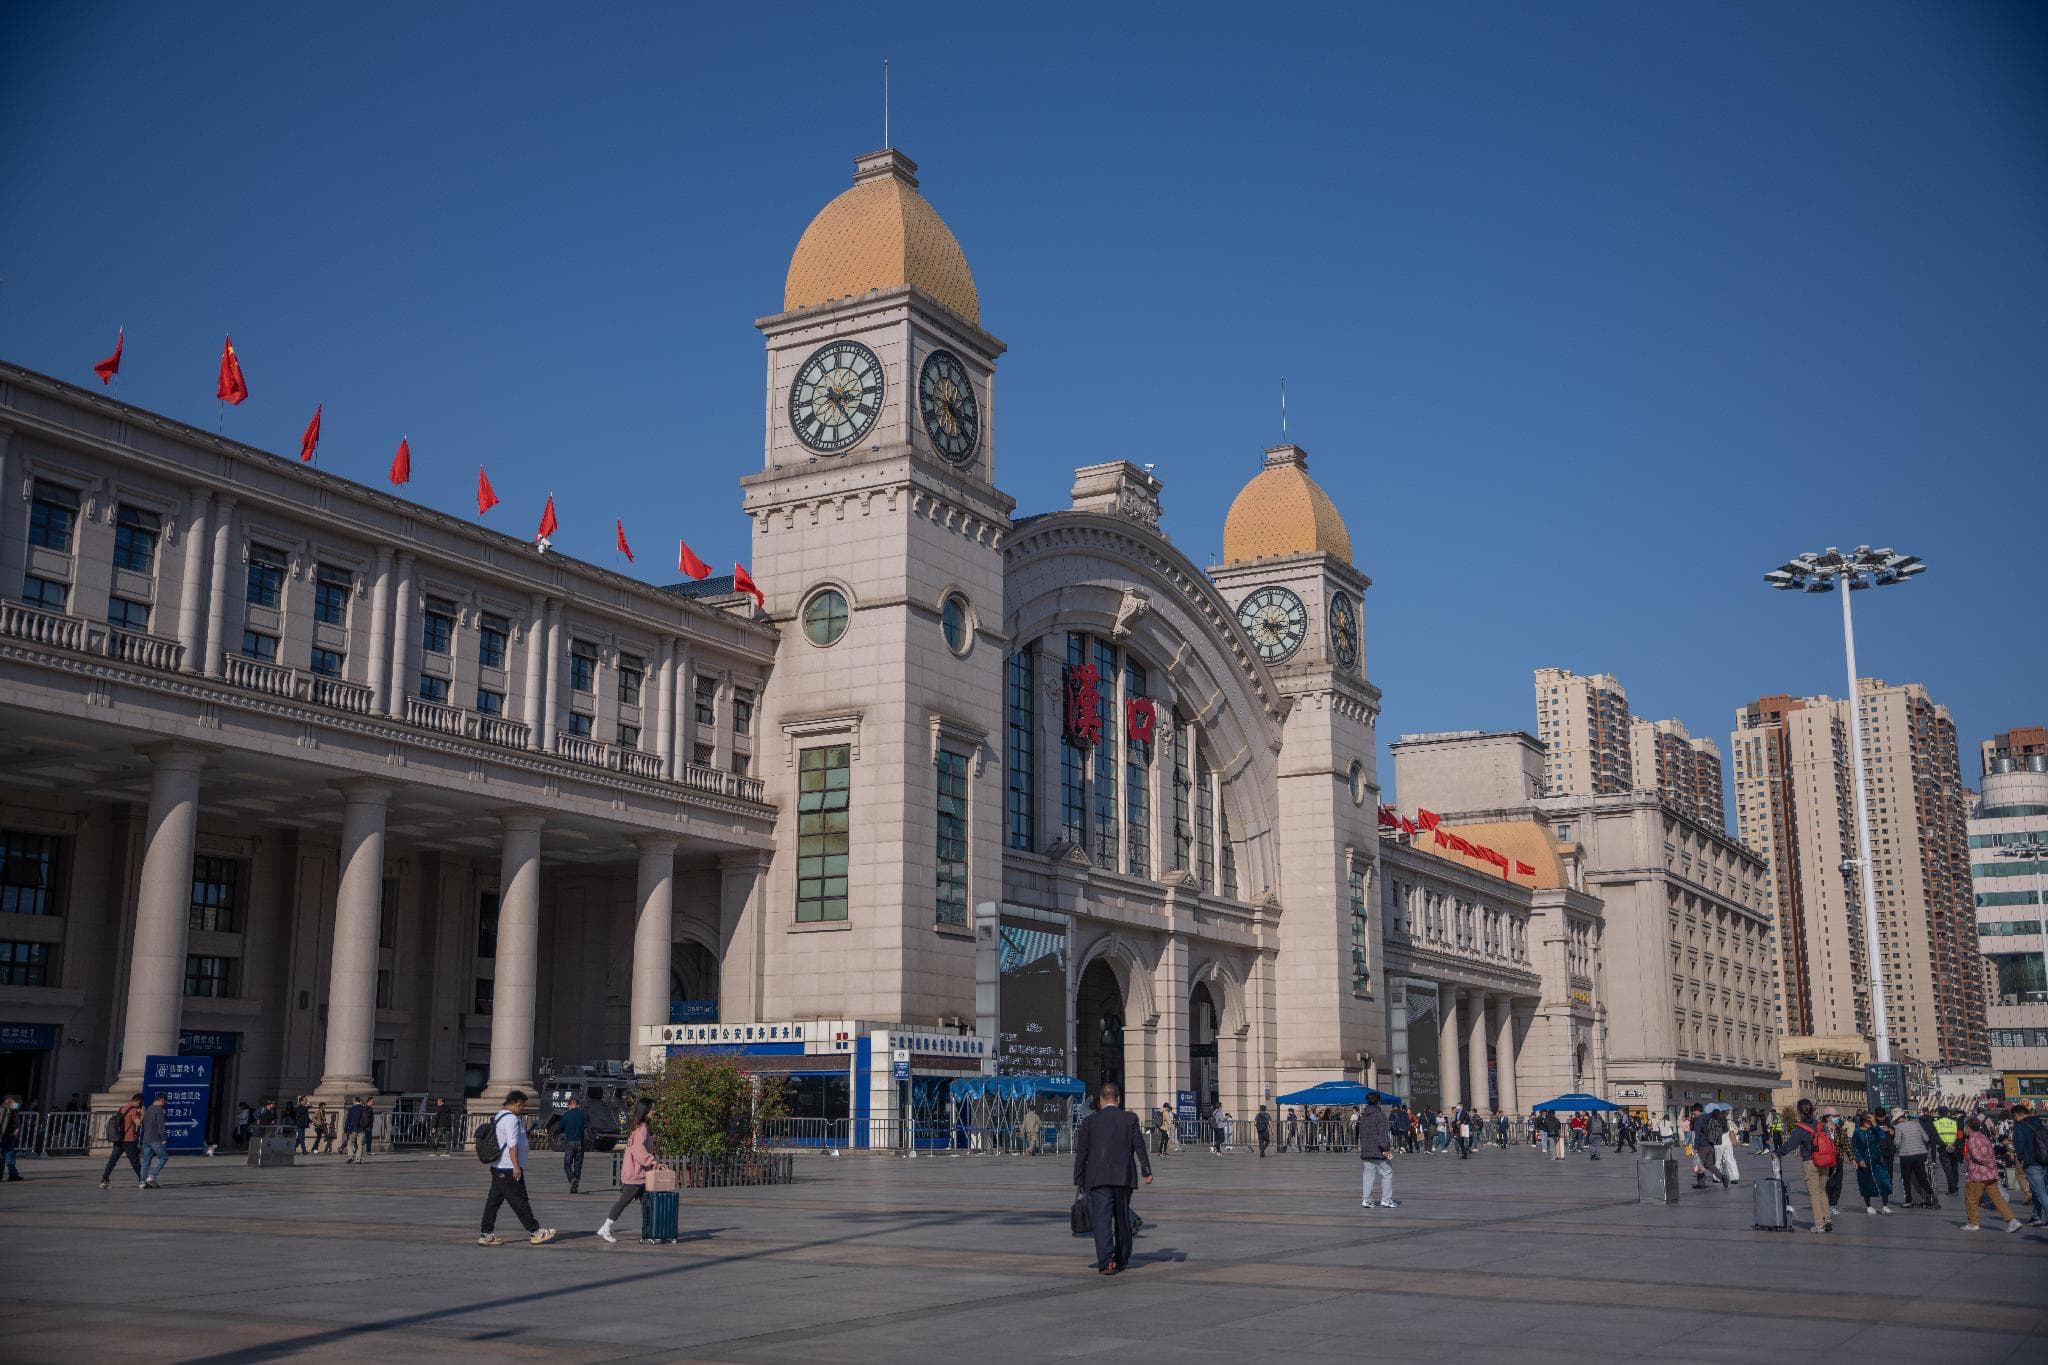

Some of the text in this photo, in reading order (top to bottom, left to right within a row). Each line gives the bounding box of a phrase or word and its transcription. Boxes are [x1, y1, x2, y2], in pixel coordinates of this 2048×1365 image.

[675, 1026, 802, 1041] 武汉铁路公安警务服务岗
